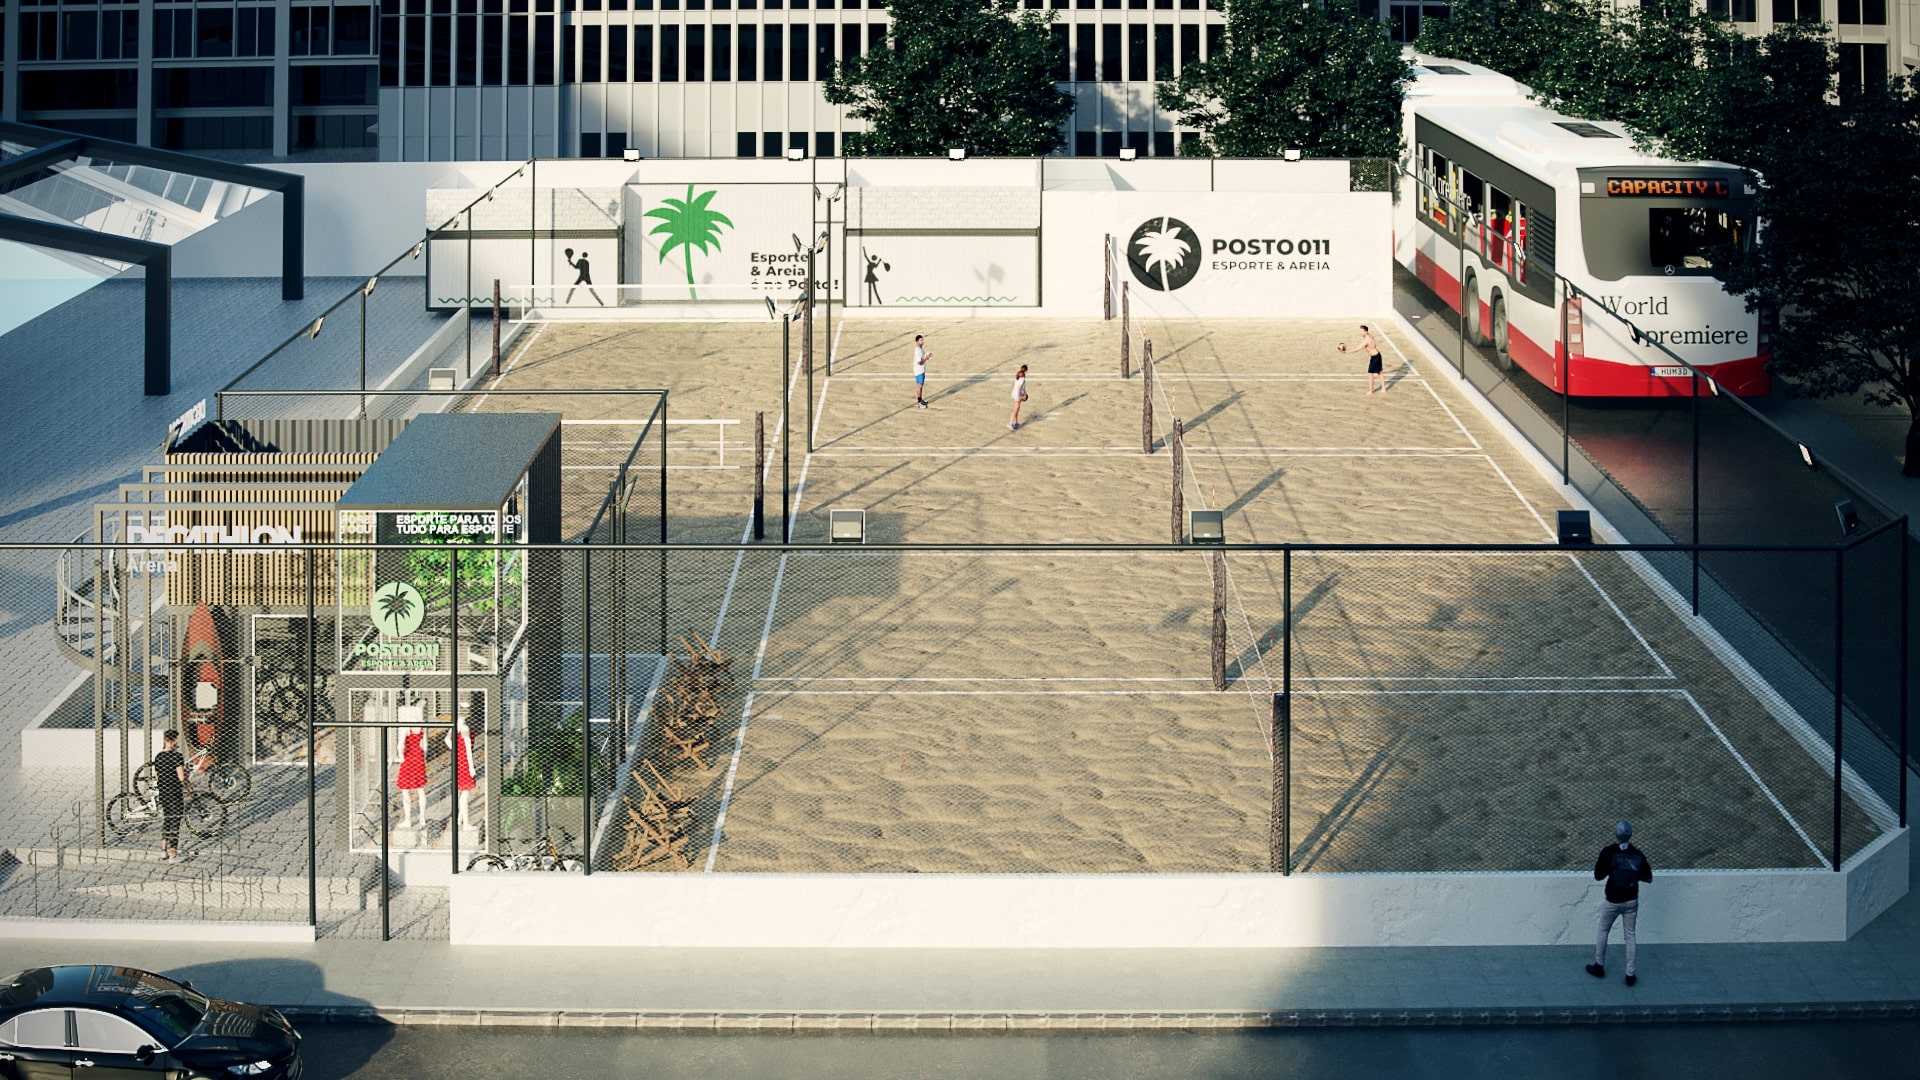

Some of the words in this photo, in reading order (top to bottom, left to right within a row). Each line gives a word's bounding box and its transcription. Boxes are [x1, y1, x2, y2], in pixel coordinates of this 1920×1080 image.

[1608, 180, 1707, 195] CAPACITY
[1715, 180, 1728, 195] L
[1212, 238, 1294, 255] POSTO
[1297, 238, 1330, 255] 011
[750, 252, 808, 264] Esporte
[1212, 261, 1273, 270] ESPORTE
[1277, 261, 1285, 270] &
[1289, 261, 1330, 270] AREIA
[750, 265, 760, 276] &
[766, 264, 805, 276] Areia
[1600, 295, 1669, 315] World
[1645, 324, 1748, 347] premiere
[396, 514, 446, 525] ESPORTE
[449, 514, 480, 525] PARA
[396, 525, 427, 535] TUDO
[429, 525, 459, 535] PARA
[126, 525, 301, 554] DECATHLON
[126, 557, 178, 573] Arena
[355, 642, 414, 656] POSTO
[416, 642, 440, 657] 011
[362, 659, 399, 667] ESPORTE
